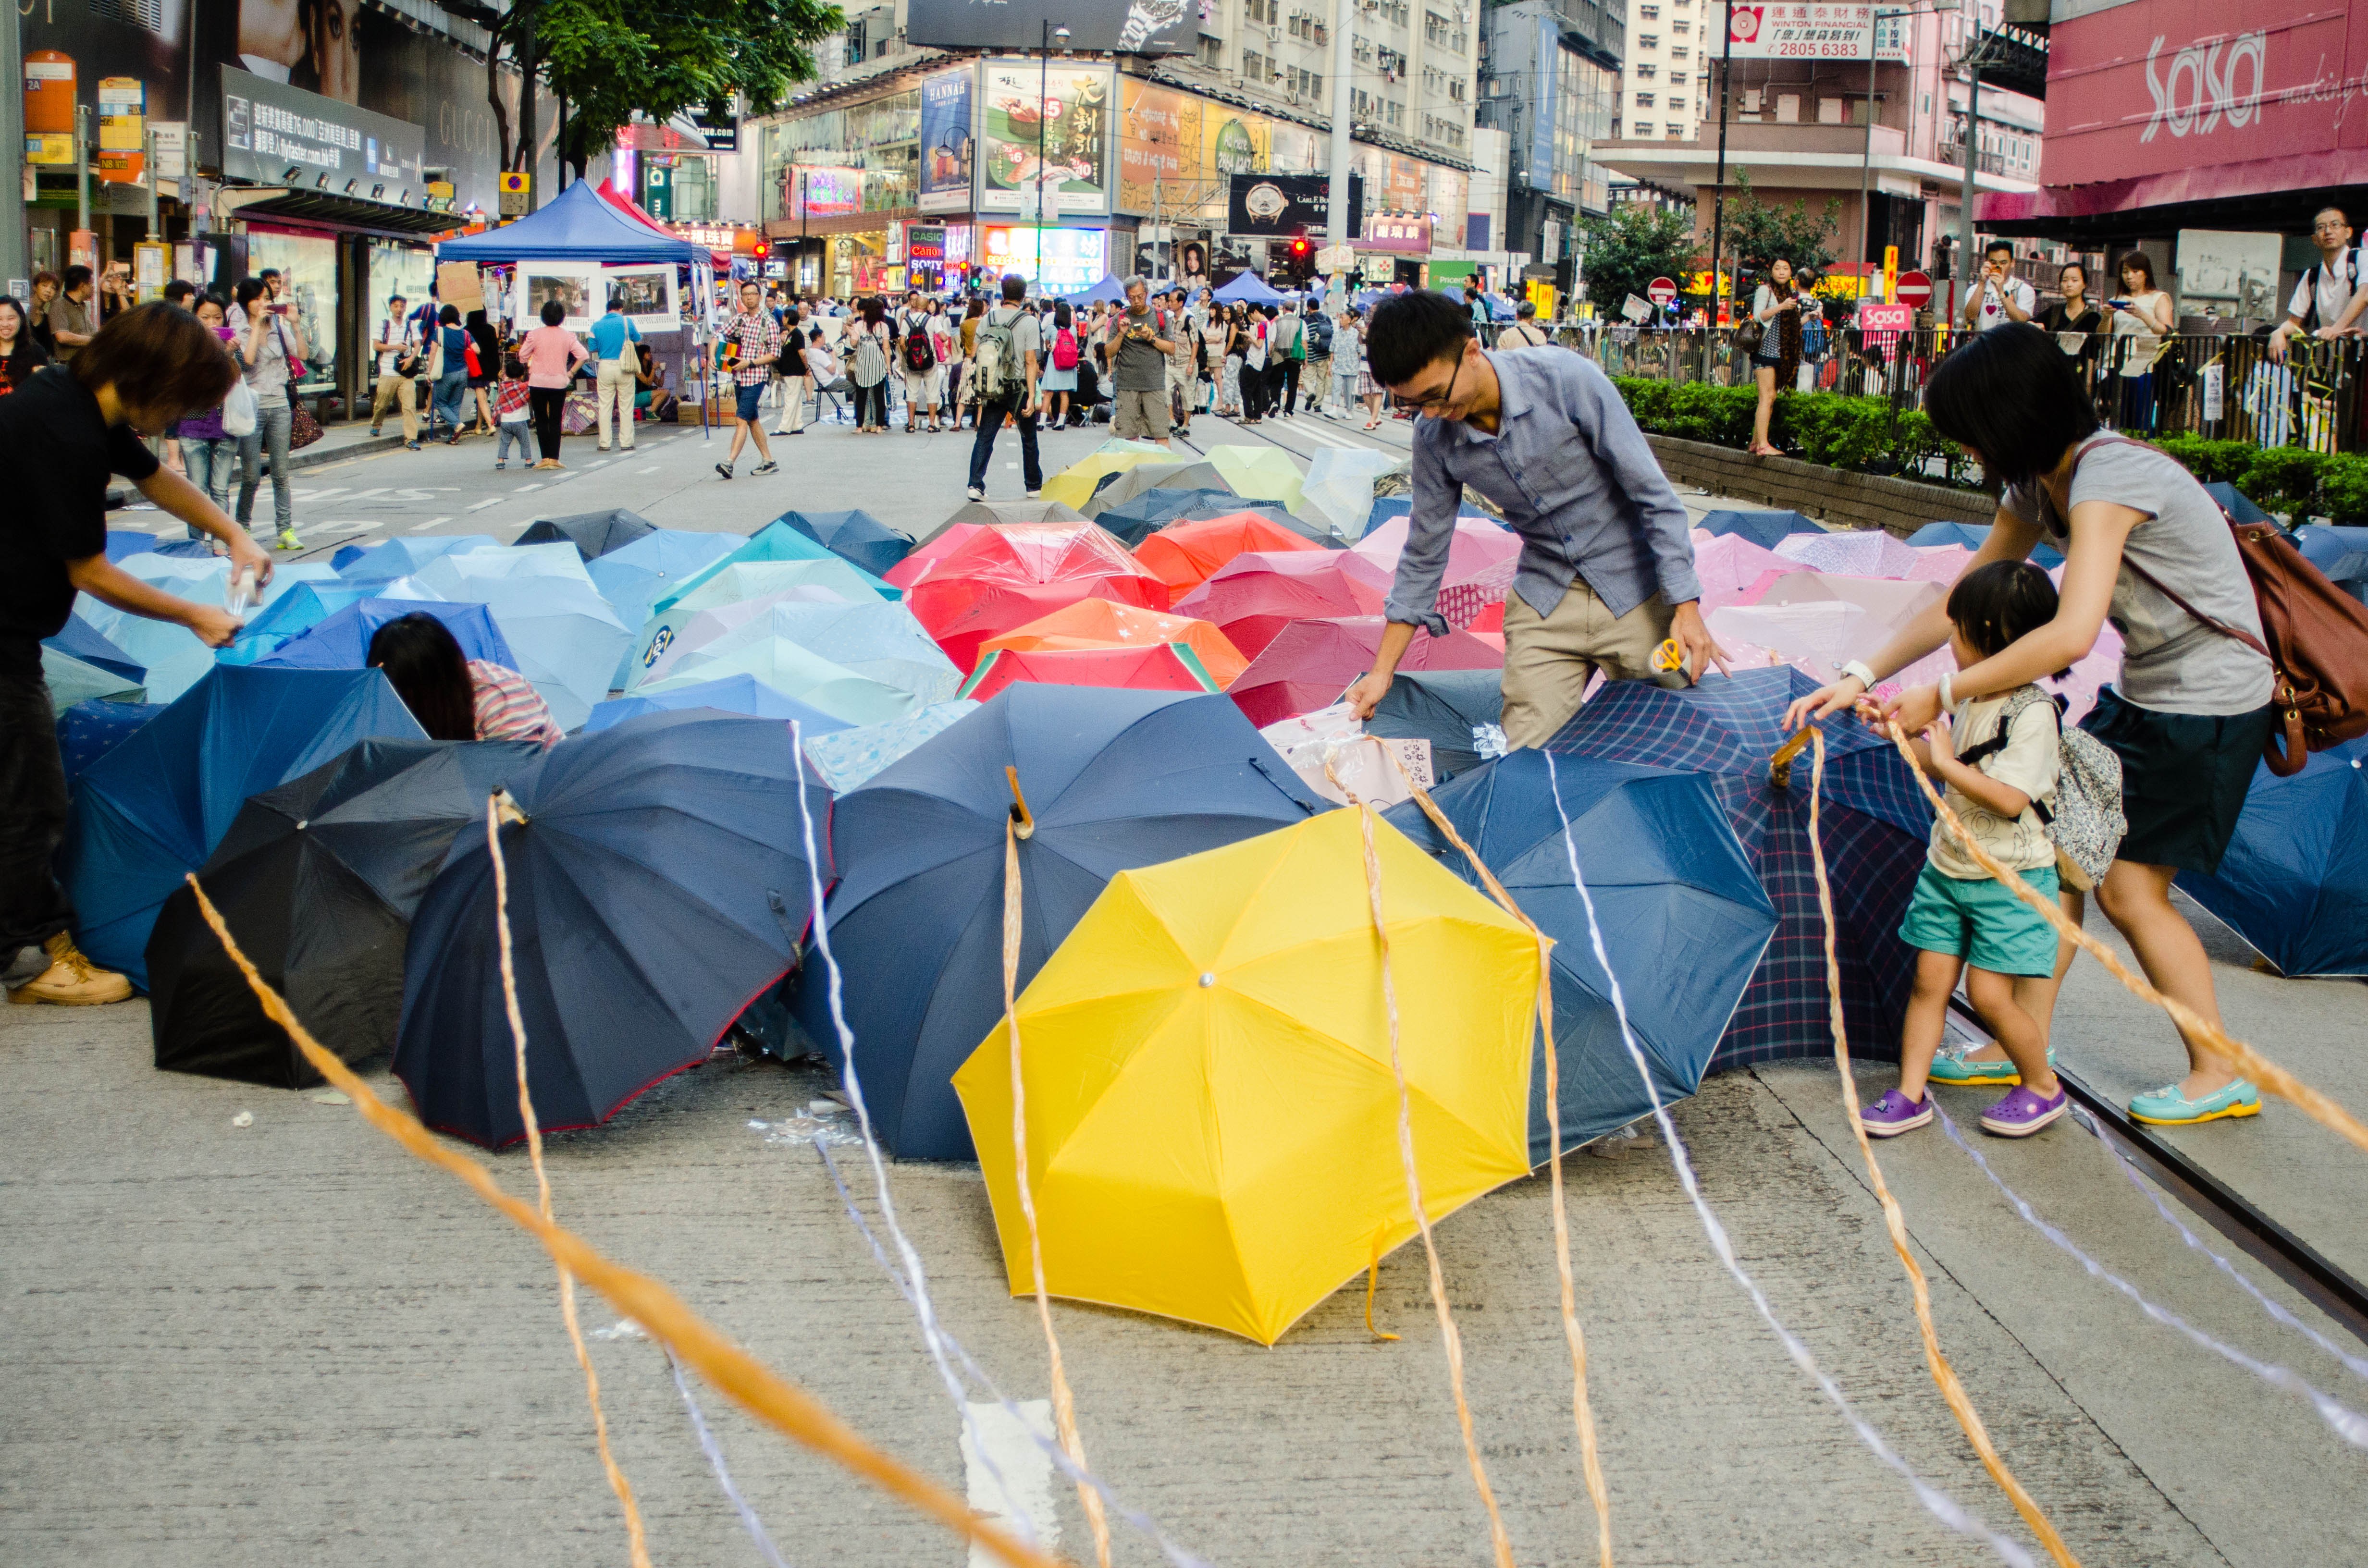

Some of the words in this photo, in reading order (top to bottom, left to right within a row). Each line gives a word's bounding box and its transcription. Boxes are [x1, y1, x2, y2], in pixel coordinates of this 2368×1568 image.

[1772, 6, 1869, 19] 運通泰財務
[1780, 43, 1821, 56] 2805
[1822, 44, 1858, 57] 6383
[930, 80, 965, 101] HANNAH
[912, 232, 943, 242] CASIO
[1376, 224, 1419, 239] 謝瑞麟
[911, 245, 943, 257] Canon
[911, 259, 943, 270] SONY
